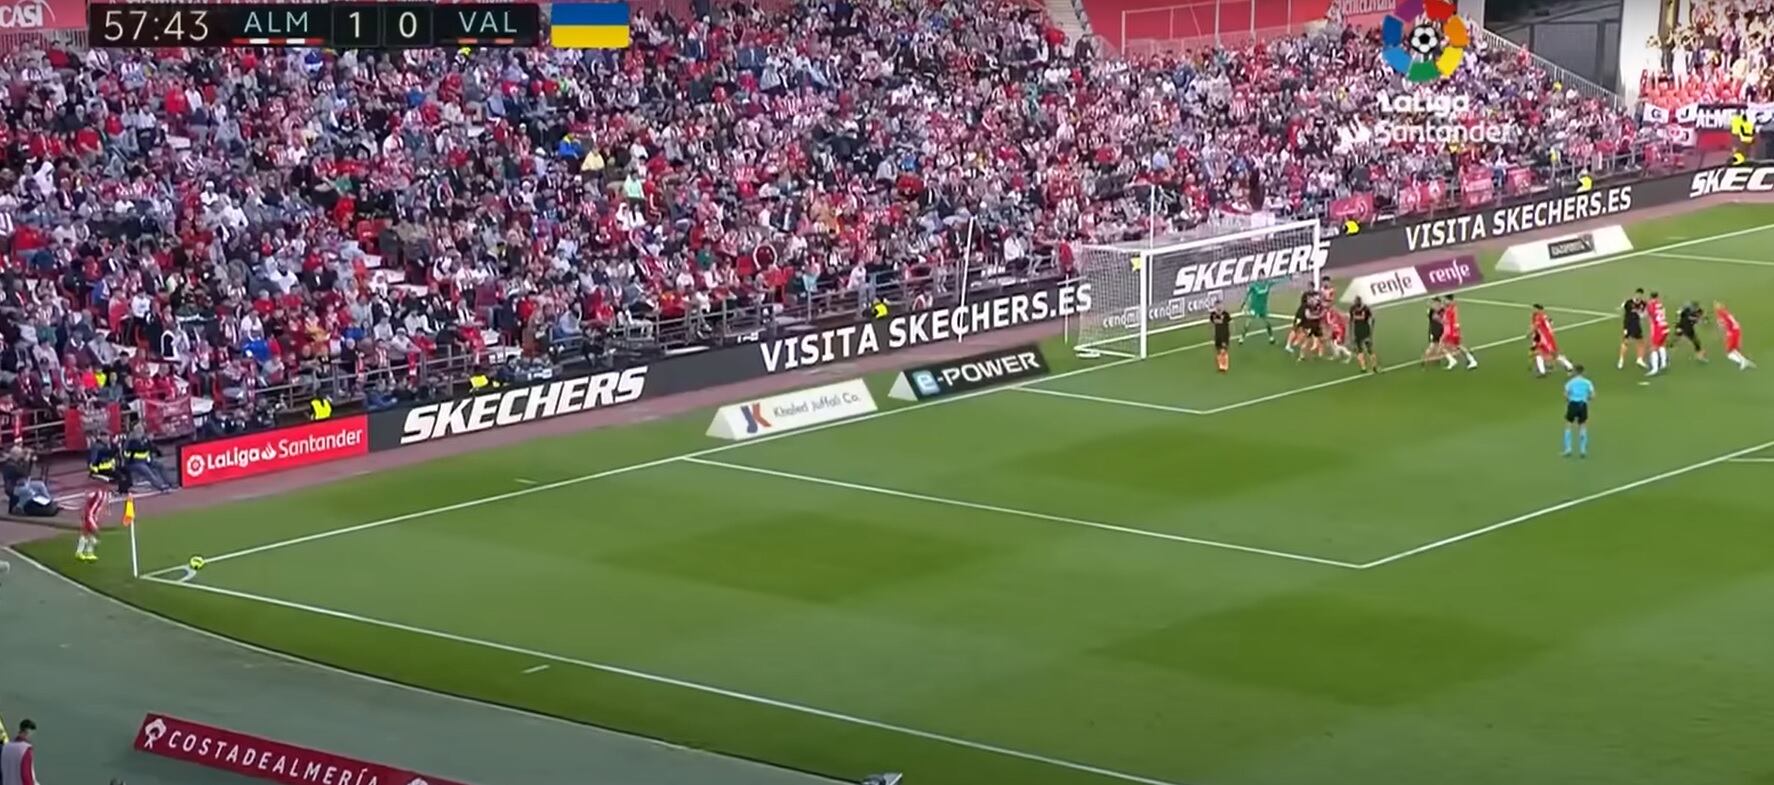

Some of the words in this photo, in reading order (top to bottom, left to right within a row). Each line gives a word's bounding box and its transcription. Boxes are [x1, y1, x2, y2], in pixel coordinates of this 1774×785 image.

[1405, 214, 1486, 251] VISITA
[1492, 186, 1633, 235] SKECHERS.ES
[1173, 241, 1330, 296] SKECHERS
[1370, 272, 1413, 296] renfe
[1429, 259, 1470, 285] renfe
[760, 323, 880, 373] VISITA
[888, 283, 1093, 349] SKECHERS.ES
[400, 366, 649, 445] SKECHERS
[773, 401, 809, 418] Khaled
[207, 445, 261, 470] LaLiga
[278, 427, 363, 459] Santander
